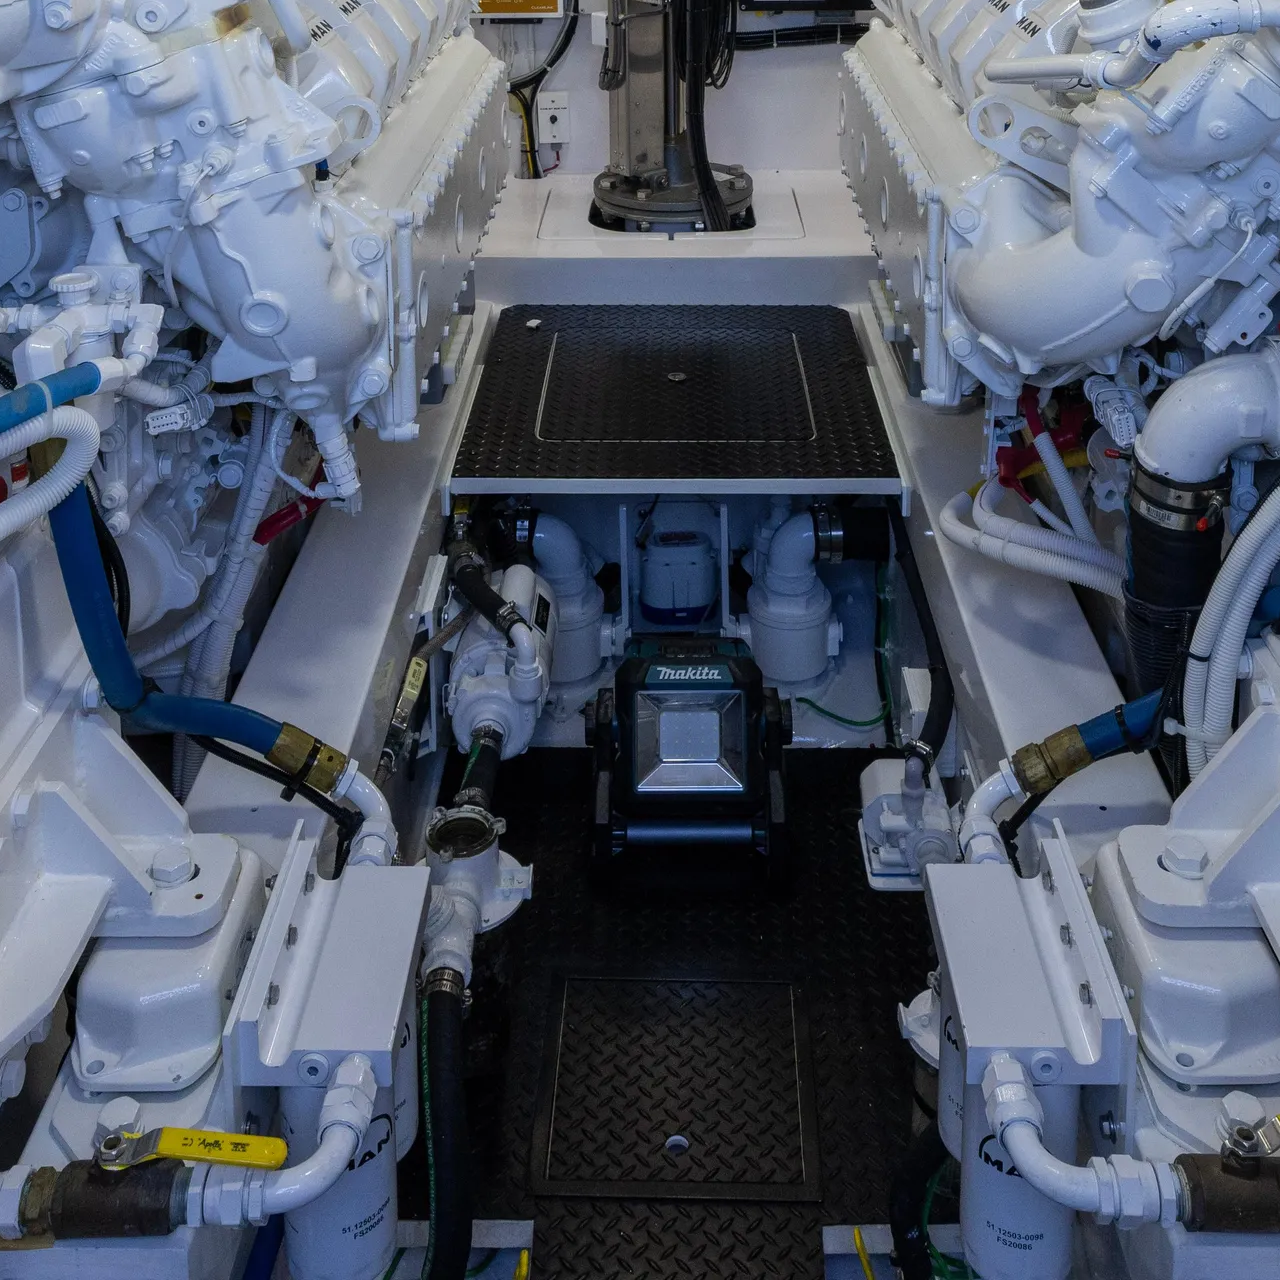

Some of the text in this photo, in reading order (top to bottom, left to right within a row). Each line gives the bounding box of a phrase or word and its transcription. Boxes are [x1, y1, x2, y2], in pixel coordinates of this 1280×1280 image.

[311, 20, 334, 42] MAN
[1016, 16, 1042, 38] MAN
[986, 1220, 1044, 1242] 51.12503-0098
[996, 1237, 1033, 1251] FS20086
